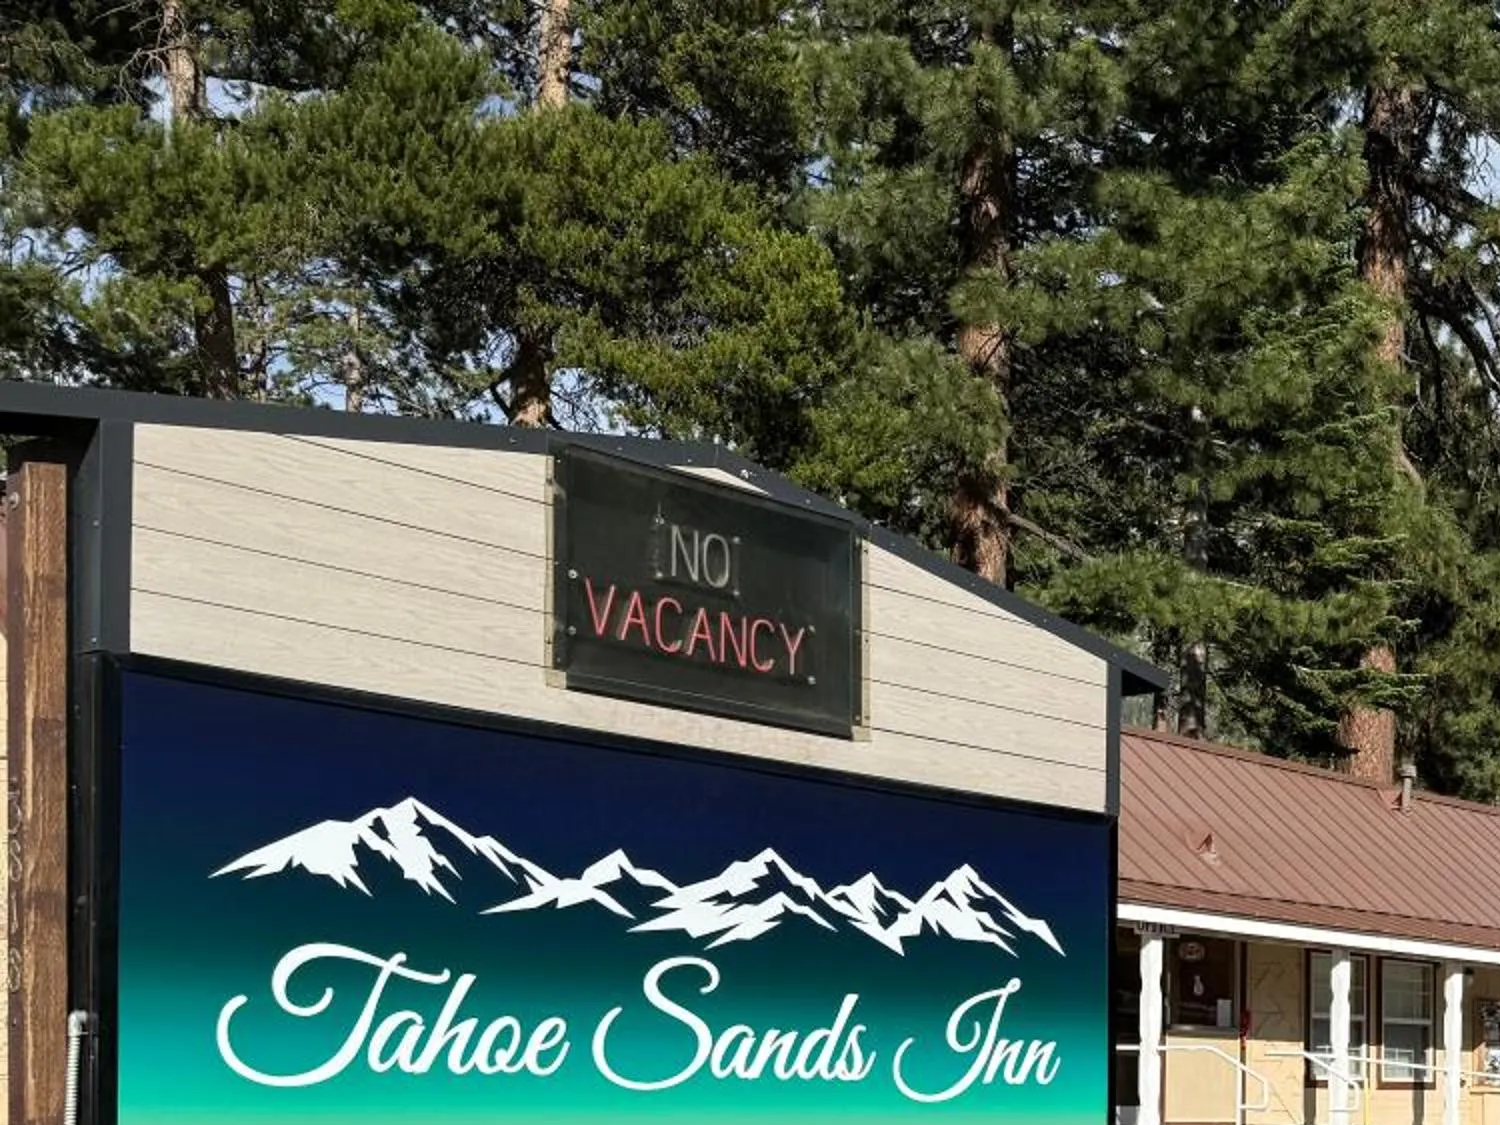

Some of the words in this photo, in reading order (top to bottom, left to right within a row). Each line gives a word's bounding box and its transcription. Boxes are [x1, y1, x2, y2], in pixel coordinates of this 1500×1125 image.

[670, 525, 732, 588] NO
[585, 576, 806, 676] VACANCY
[217, 943, 570, 1087] Tahoe
[592, 956, 876, 1091] Sands
[893, 978, 1061, 1103] Inn
